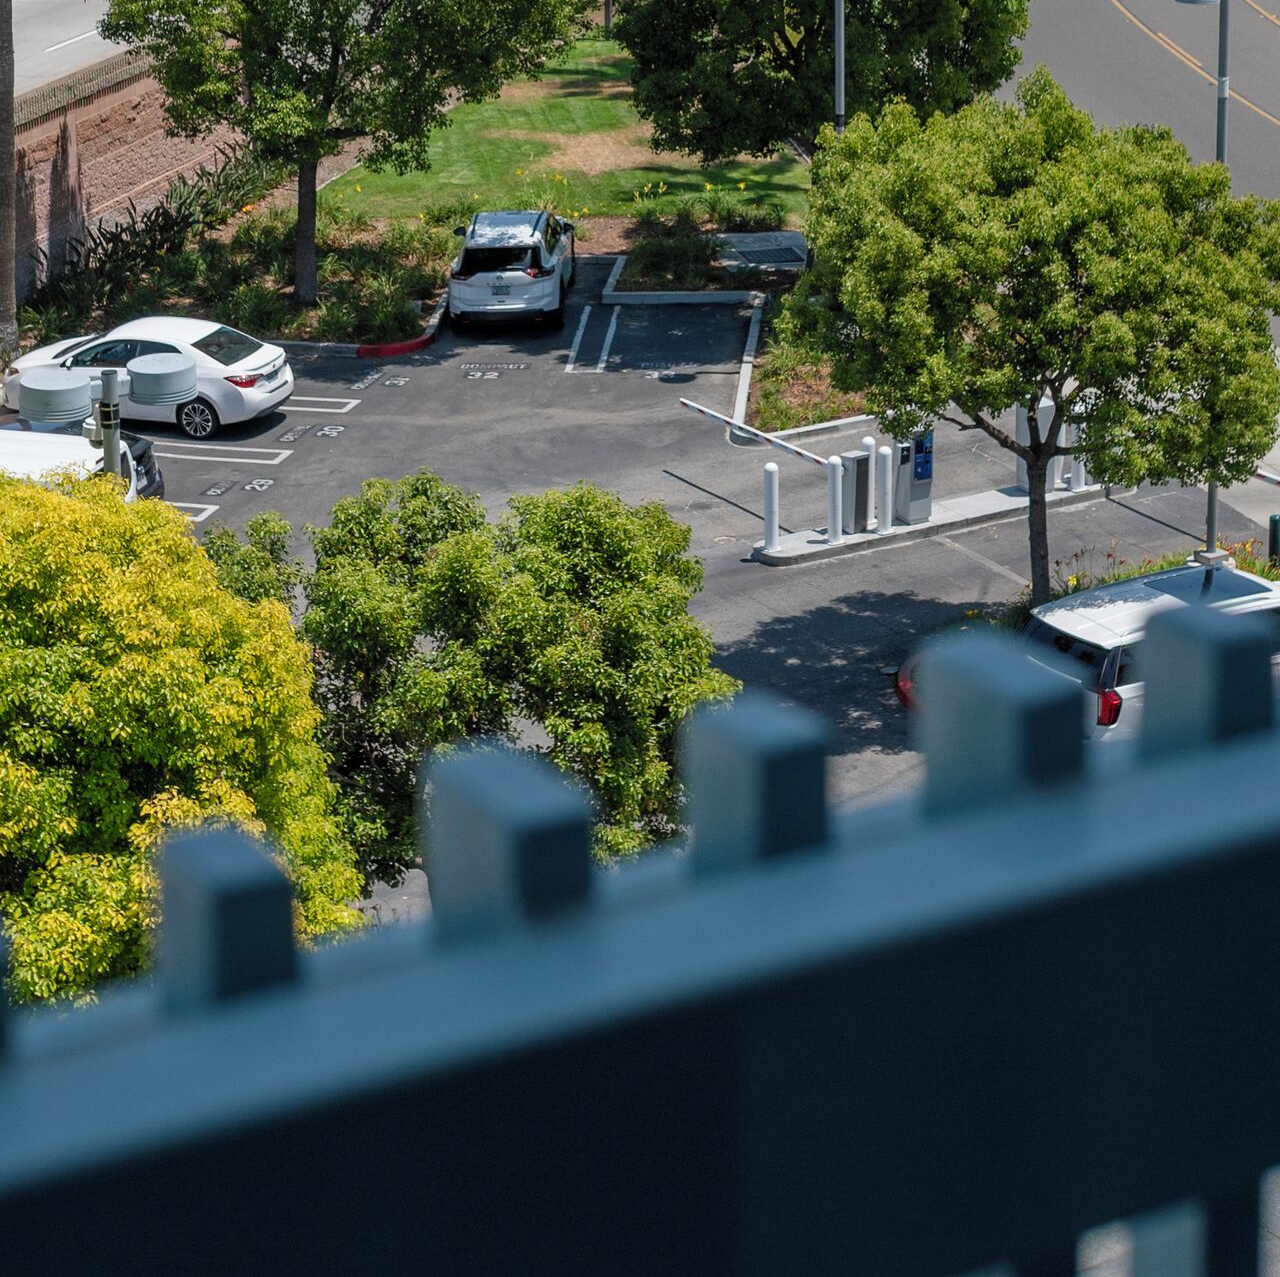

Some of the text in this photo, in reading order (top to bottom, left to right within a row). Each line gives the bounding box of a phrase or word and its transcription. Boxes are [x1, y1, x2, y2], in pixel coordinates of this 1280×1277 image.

[467, 371, 499, 379] 32
[316, 425, 345, 437] 30
[244, 479, 274, 491] 29
